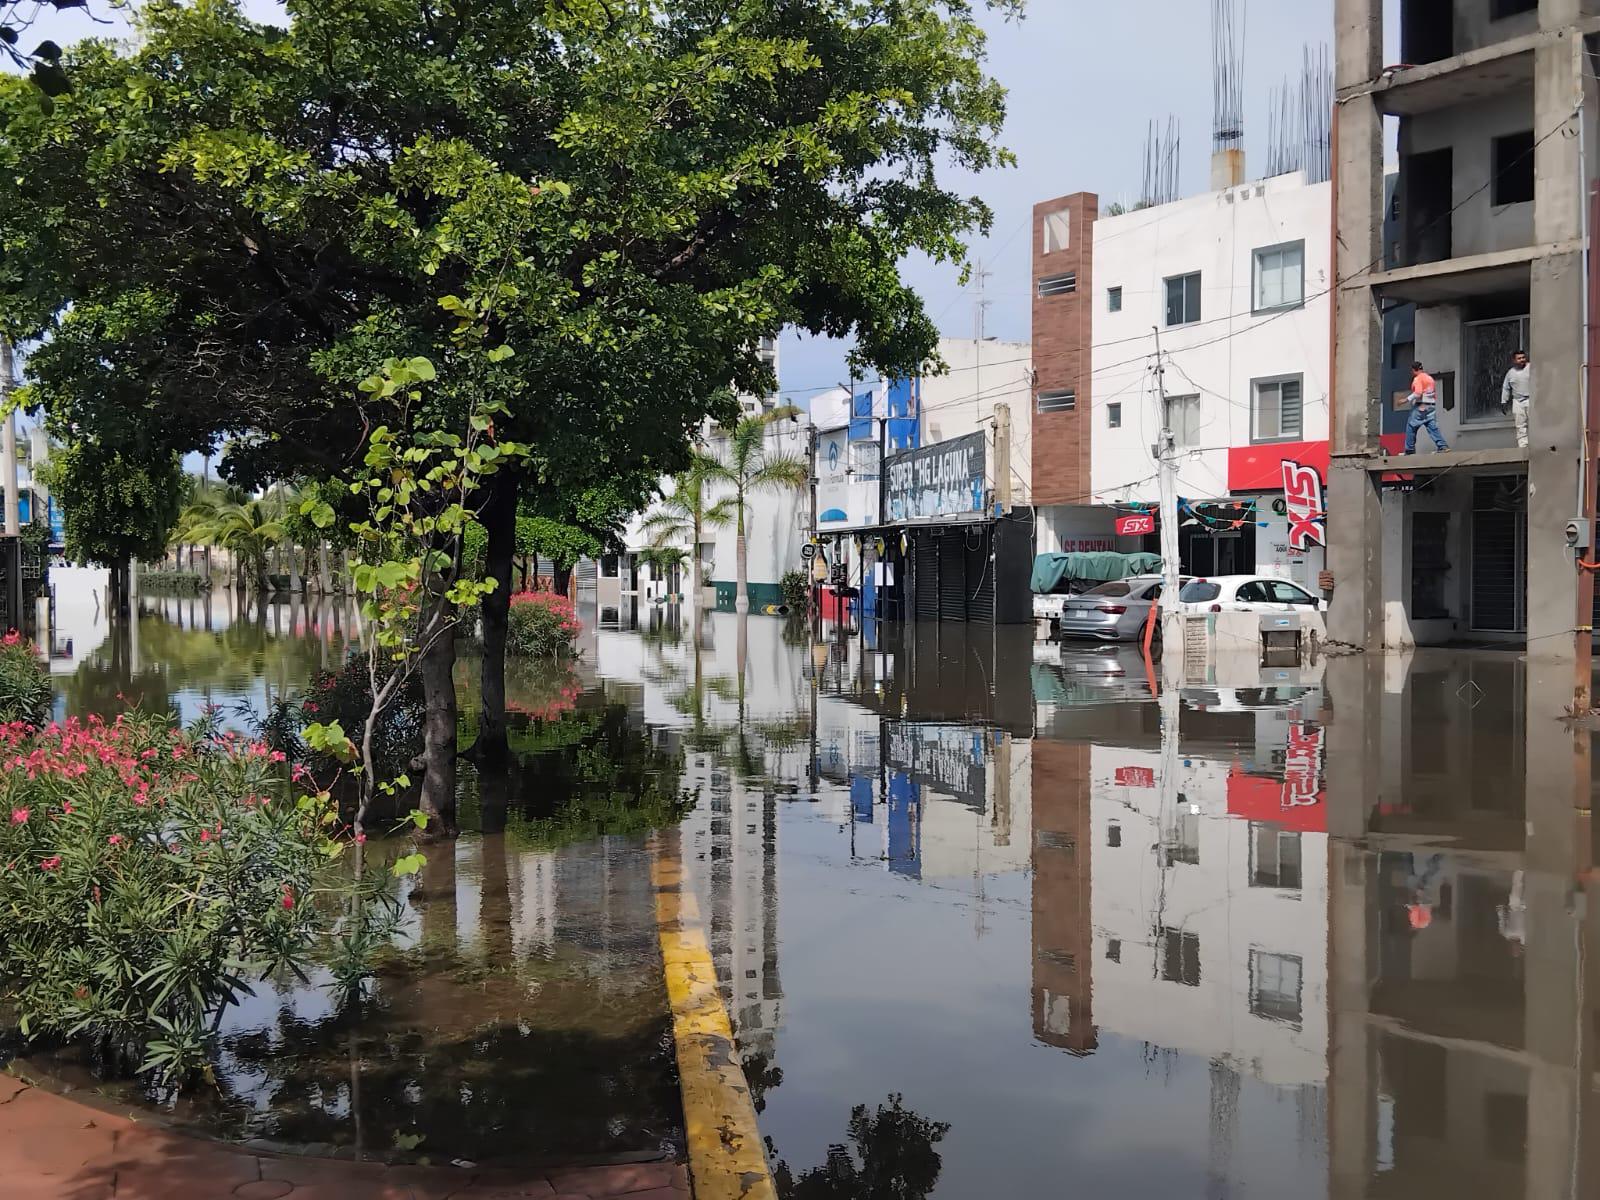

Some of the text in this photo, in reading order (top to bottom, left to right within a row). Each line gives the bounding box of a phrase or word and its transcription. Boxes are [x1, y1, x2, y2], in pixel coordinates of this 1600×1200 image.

[889, 461, 914, 492] SUPER
[1281, 459, 1326, 550] SIX
[1122, 517, 1149, 533] SIX
